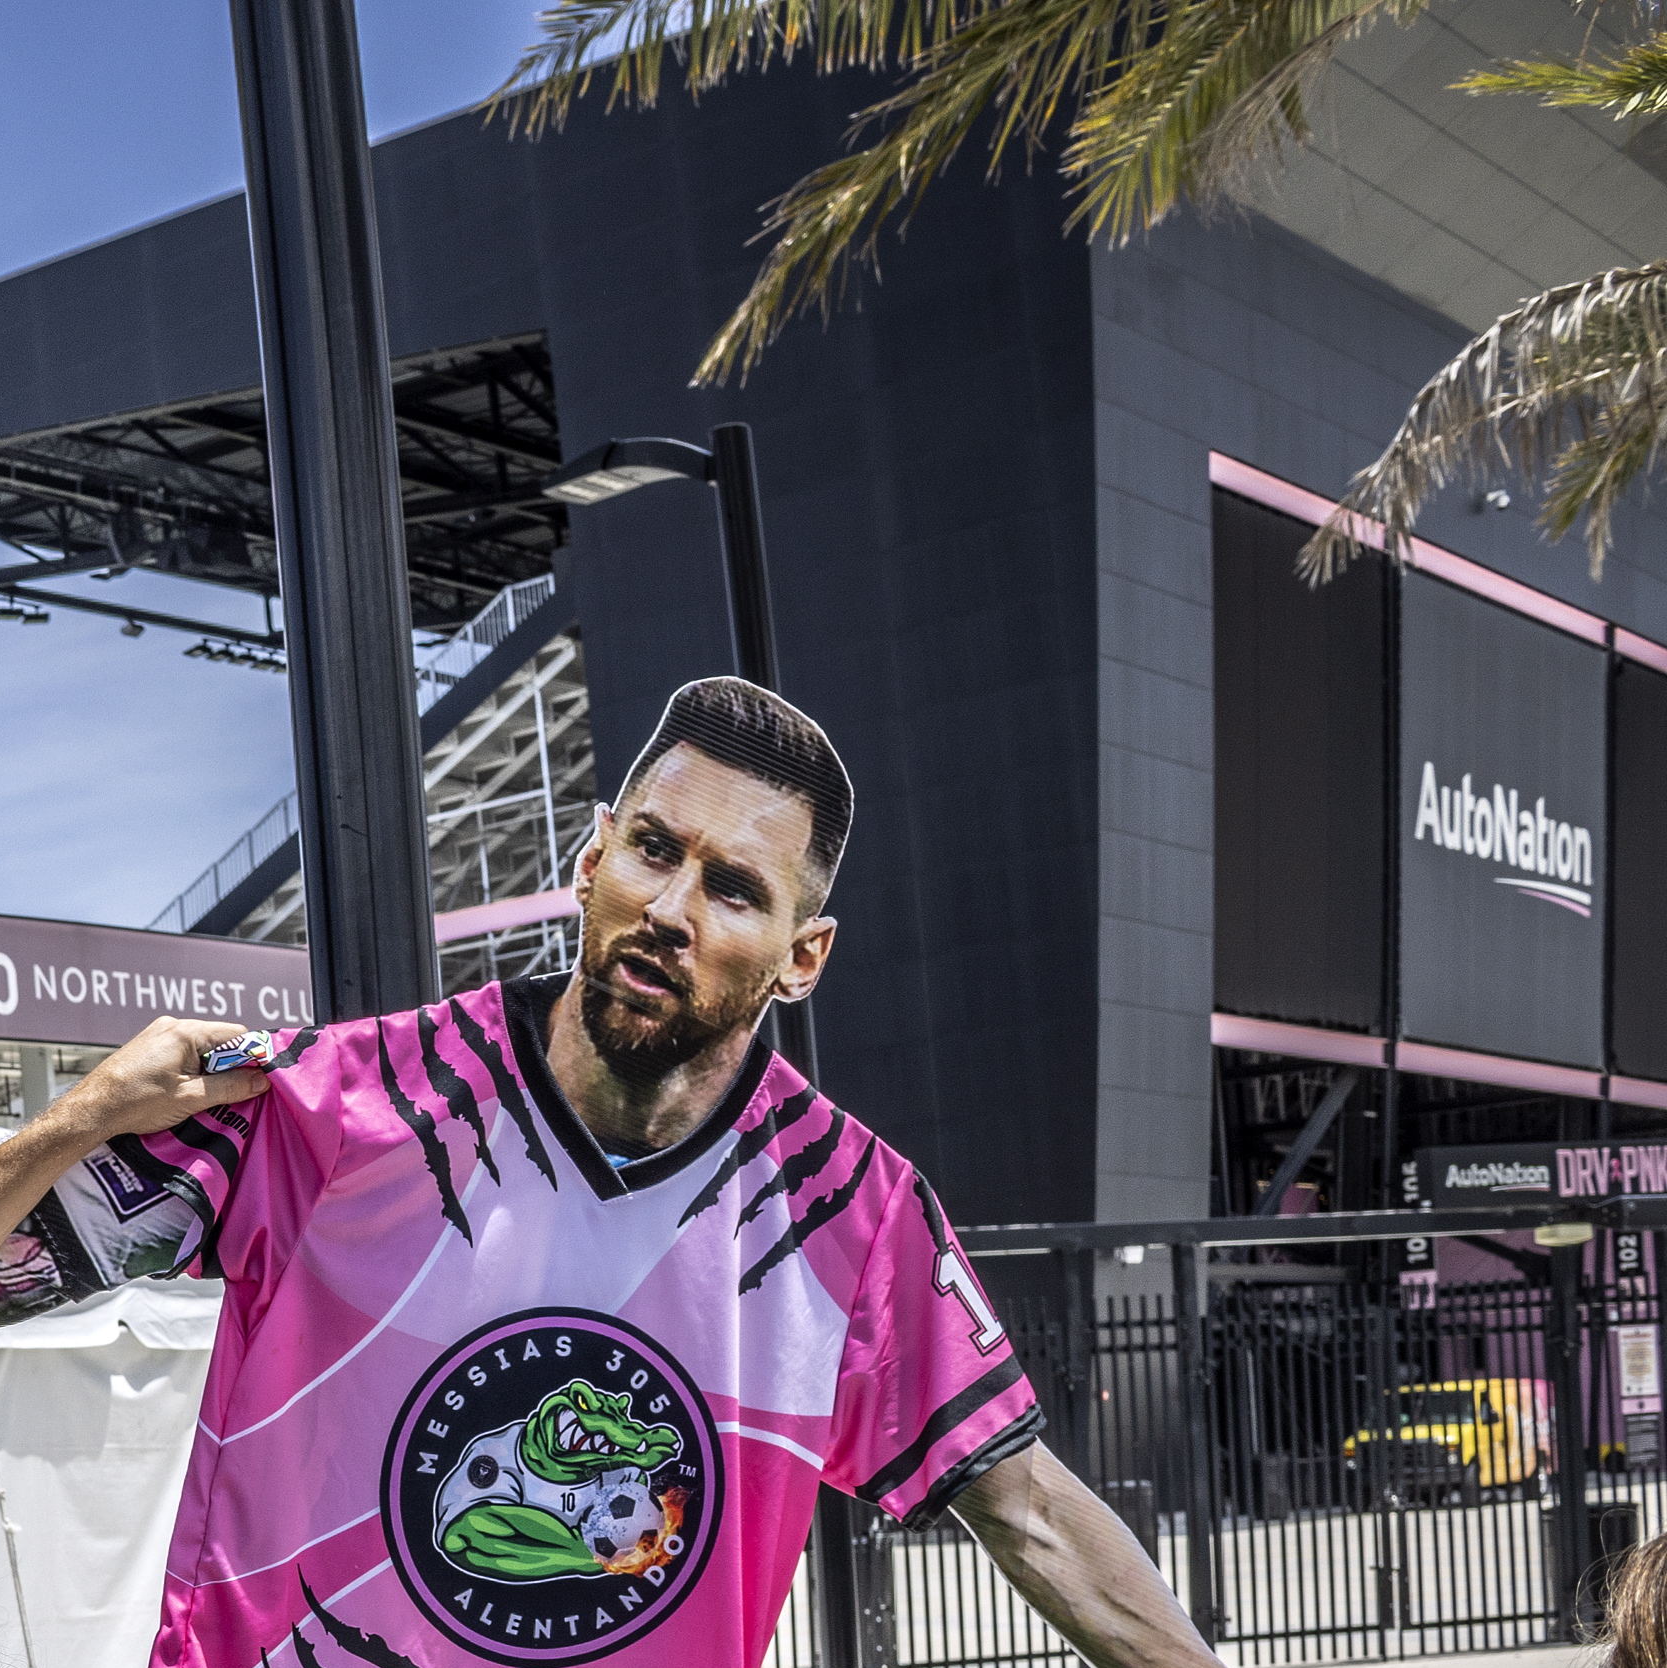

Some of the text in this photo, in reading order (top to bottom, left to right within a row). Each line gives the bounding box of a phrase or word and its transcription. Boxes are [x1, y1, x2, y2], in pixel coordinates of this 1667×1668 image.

[1415, 761, 1592, 886] AutoNation
[32, 962, 245, 1021] NORTHWEST
[1445, 1162, 1551, 1190] AutoNation
[1556, 1147, 1610, 1197] DRV
[1618, 1234, 1639, 1272] 102
[415, 1335, 671, 1476] MESSIAS 305
[560, 1492, 576, 1513] 10
[453, 1533, 686, 1640] ALENTANDO
